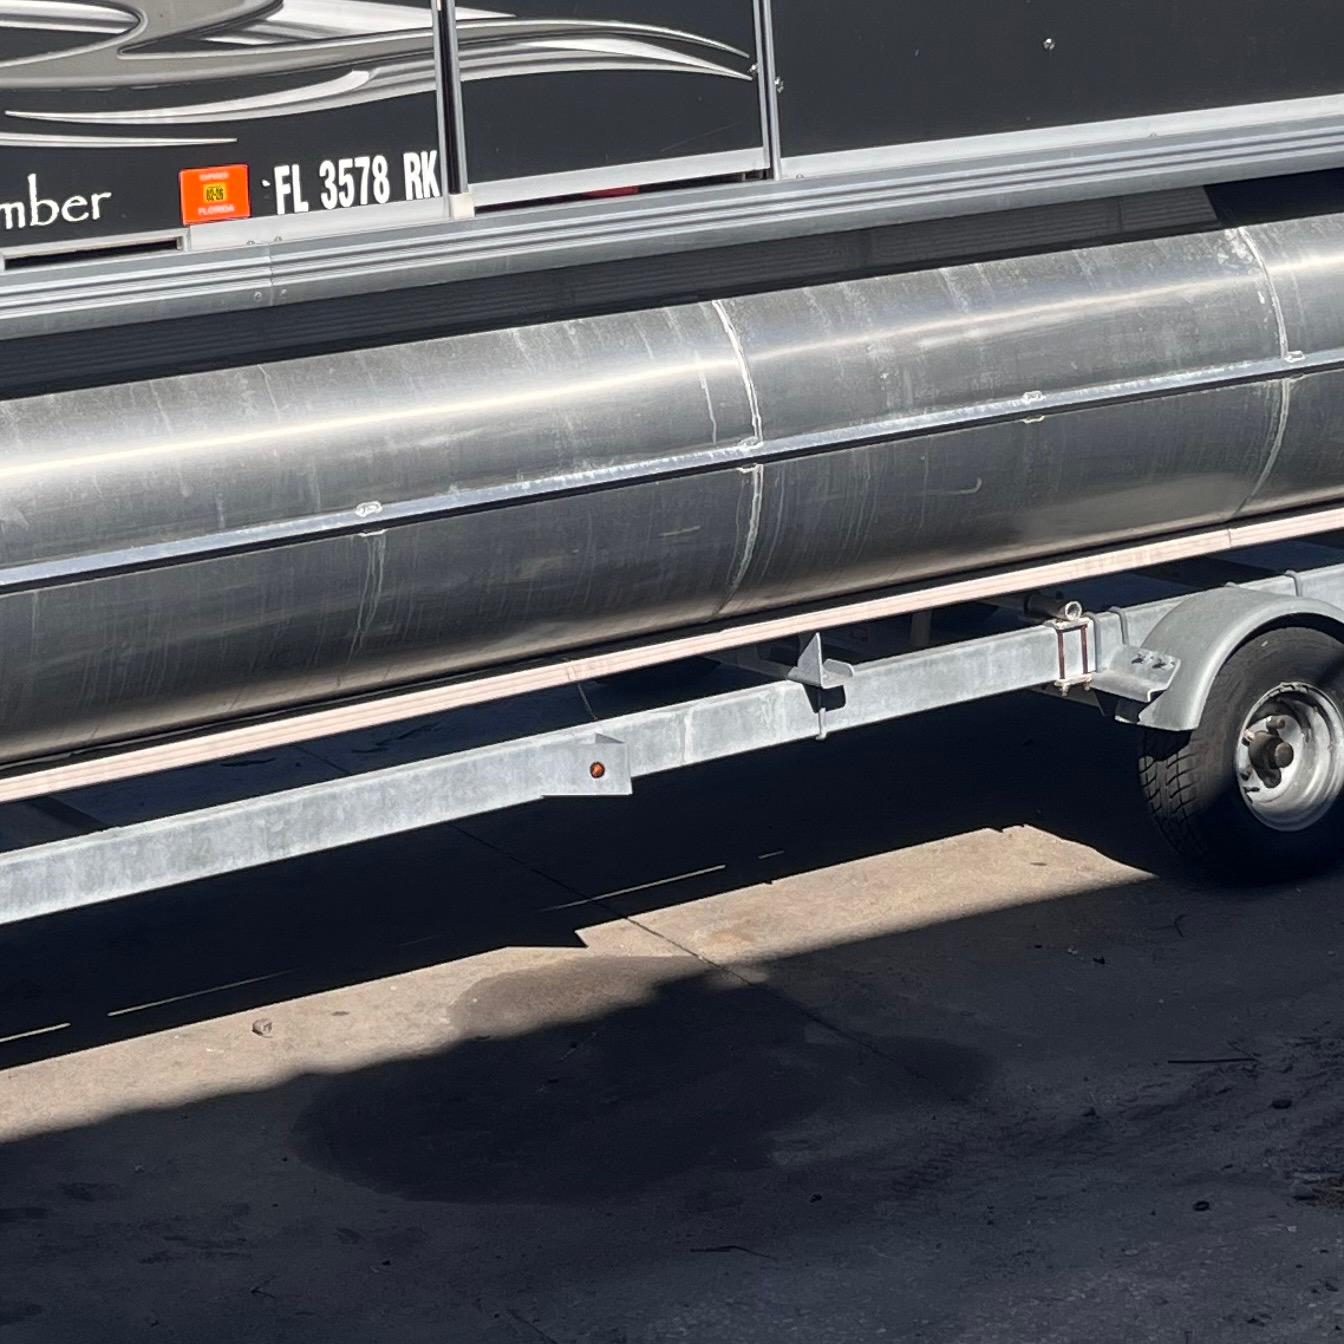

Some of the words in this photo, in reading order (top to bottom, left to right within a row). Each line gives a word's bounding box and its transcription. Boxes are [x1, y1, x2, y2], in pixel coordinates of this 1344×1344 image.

[273, 164, 309, 215] FL
[319, 155, 391, 209] 3578
[403, 150, 440, 200] RK
